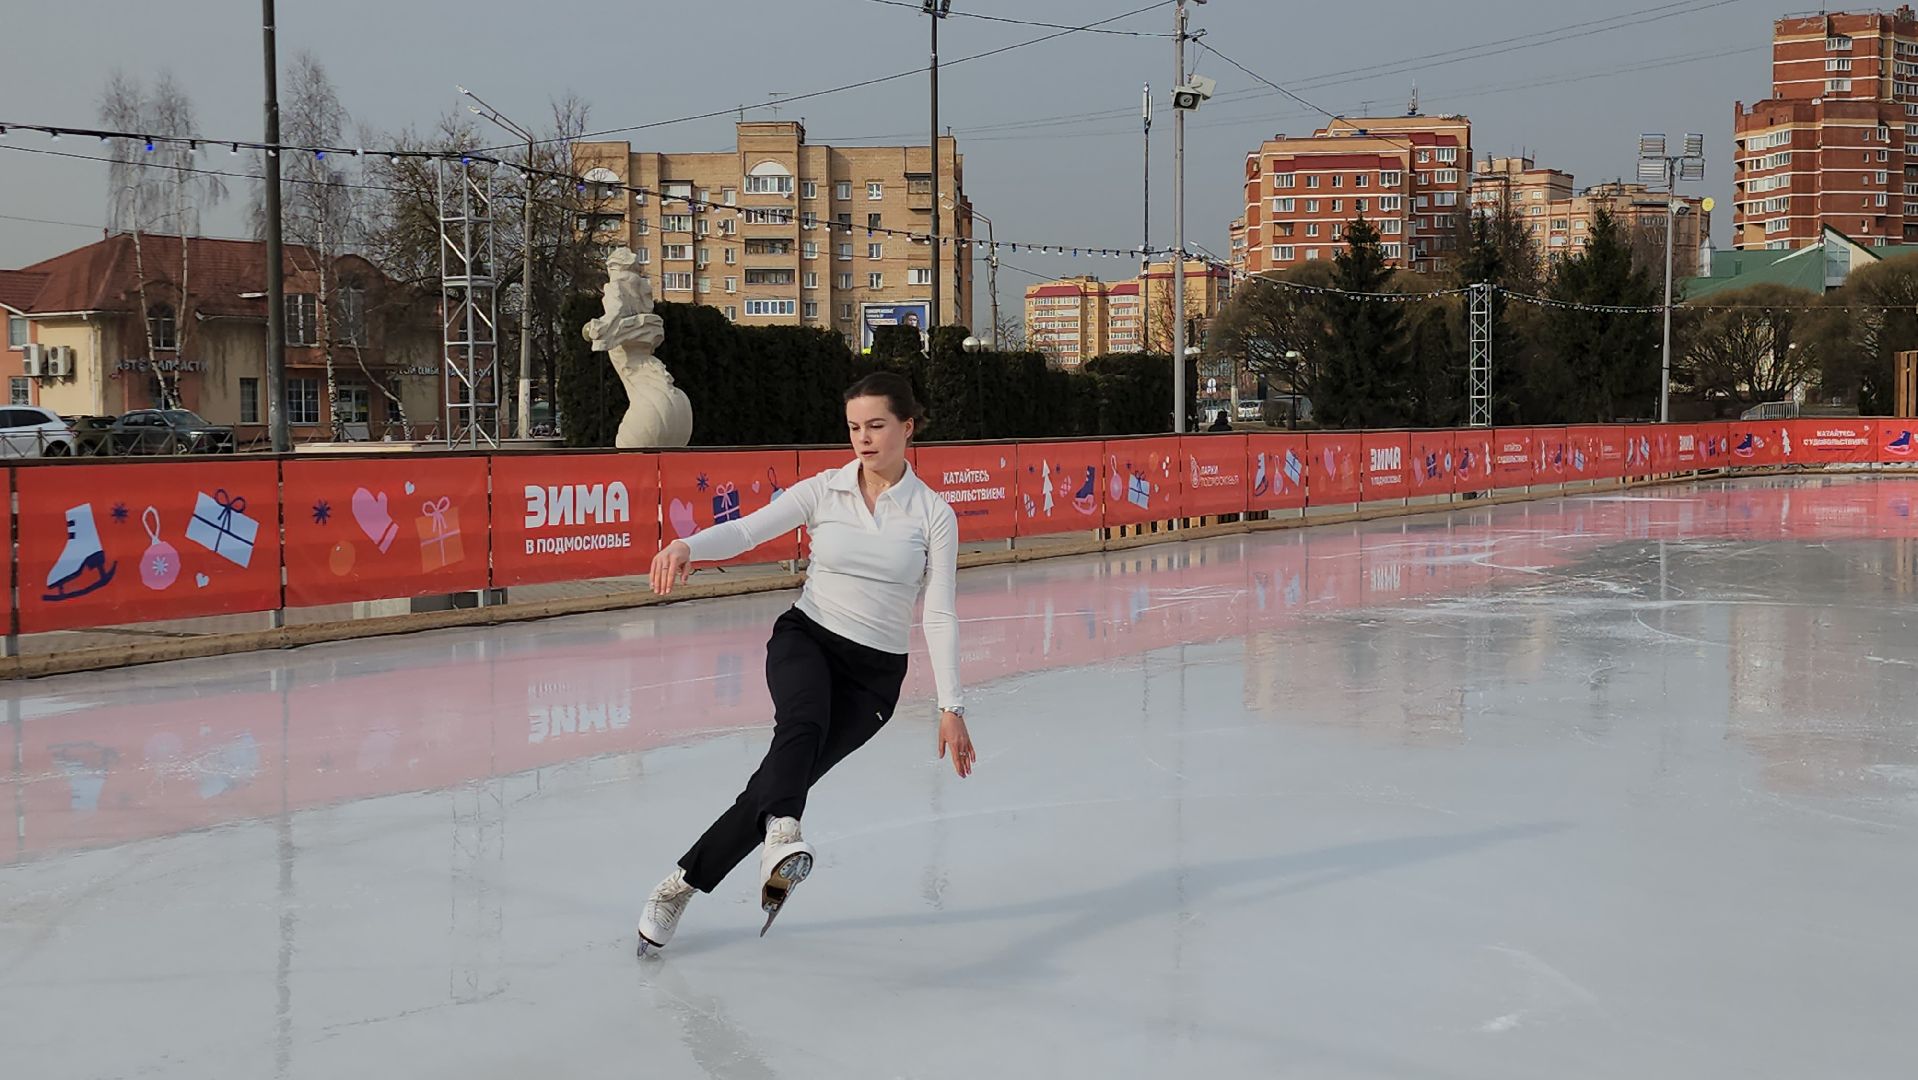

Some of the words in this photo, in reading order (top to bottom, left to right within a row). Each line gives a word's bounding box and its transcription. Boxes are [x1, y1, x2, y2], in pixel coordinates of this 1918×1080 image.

[1370, 446, 1402, 471] ЗИМА
[943, 468, 990, 485] КАТАЙТЕСЬ
[524, 481, 630, 529] ЗИМА
[937, 487, 1006, 503] ДОВОЛЬСТВИЕМ!
[525, 539, 535, 554] В
[536, 532, 632, 555] ПОДМОСКОВЬЕ
